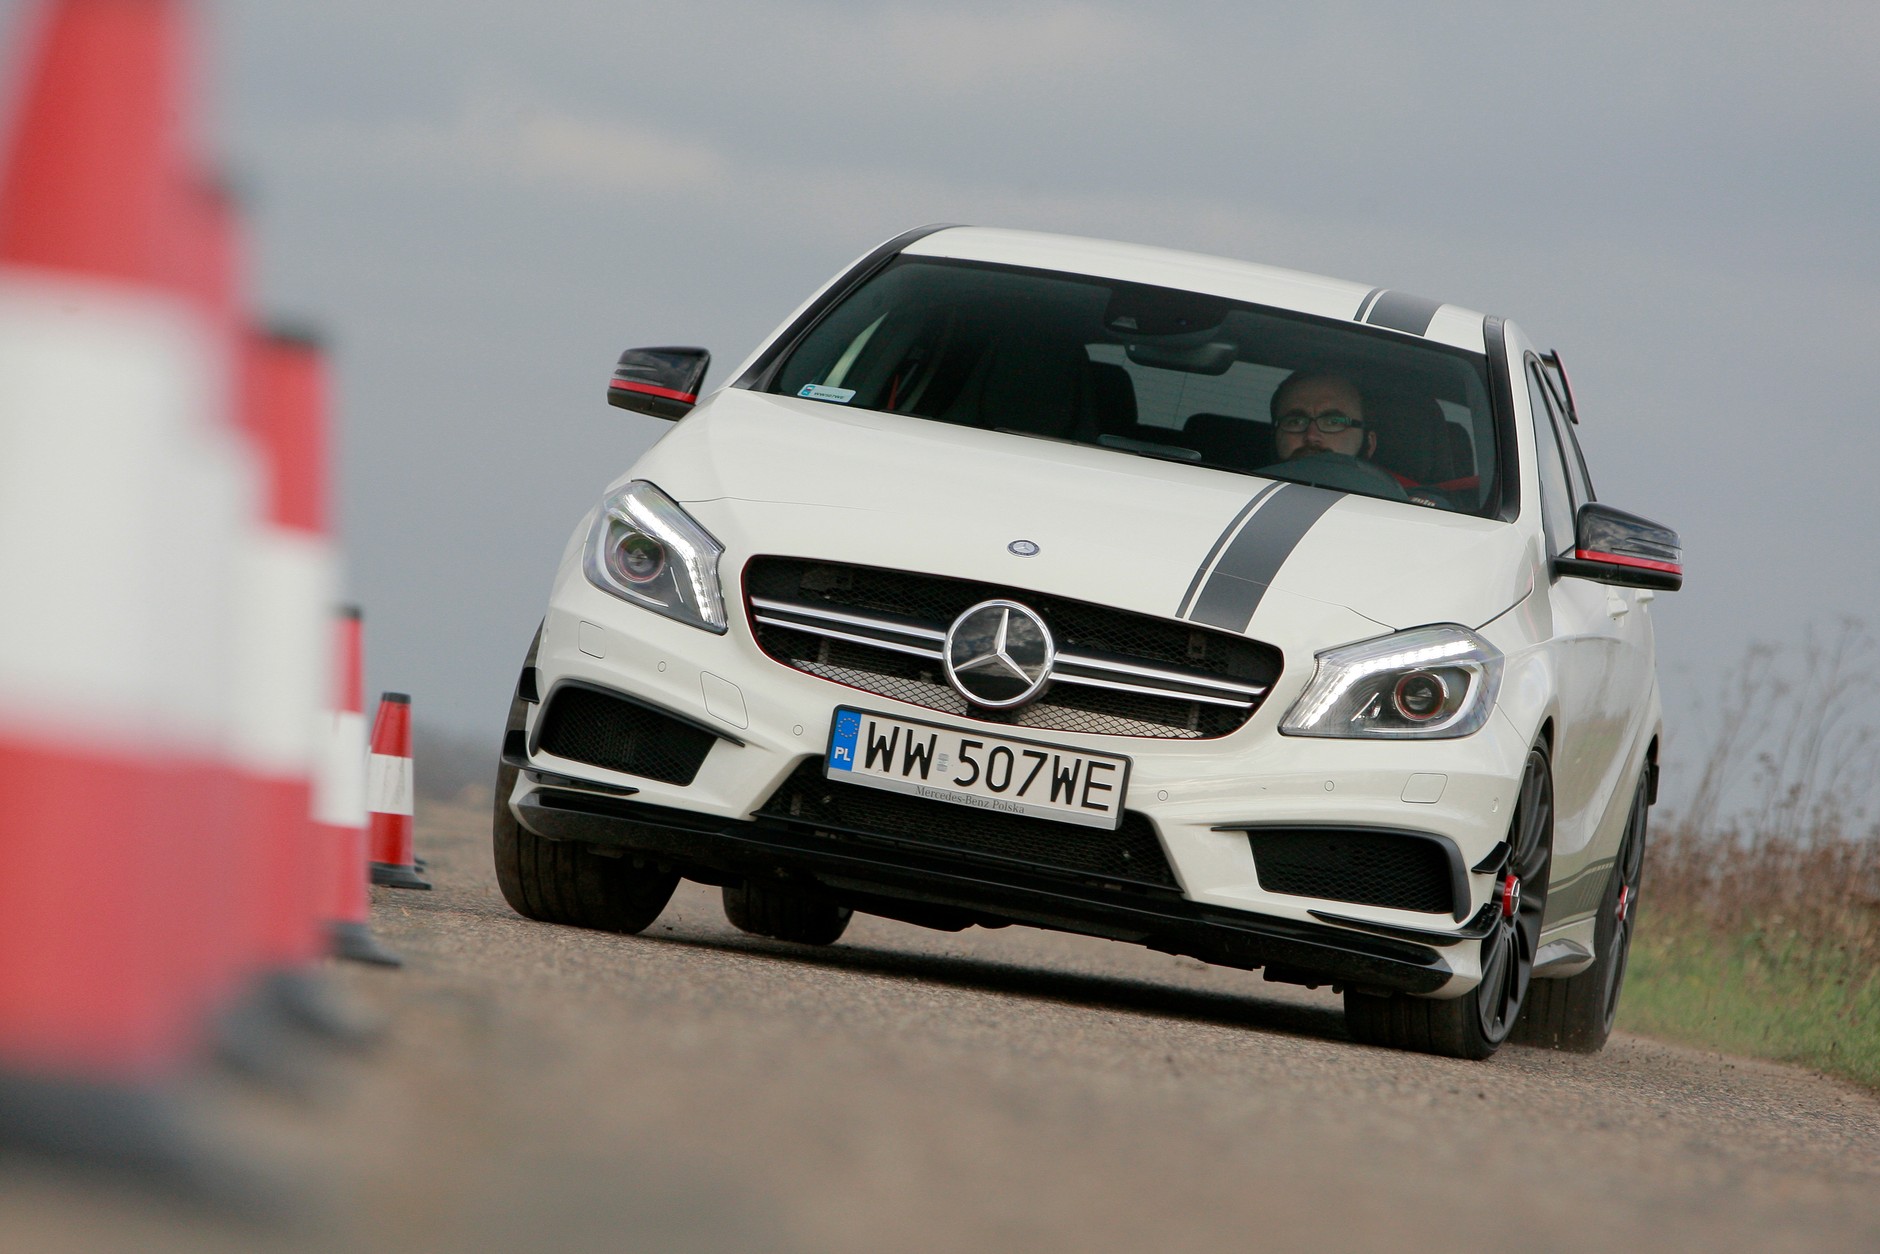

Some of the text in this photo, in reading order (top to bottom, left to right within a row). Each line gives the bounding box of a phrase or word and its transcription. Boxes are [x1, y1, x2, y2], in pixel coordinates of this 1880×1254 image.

[834, 746, 851, 762] PL
[952, 738, 1116, 811] 507WE
[914, 785, 1025, 814] Mercedes-Benz Polska
